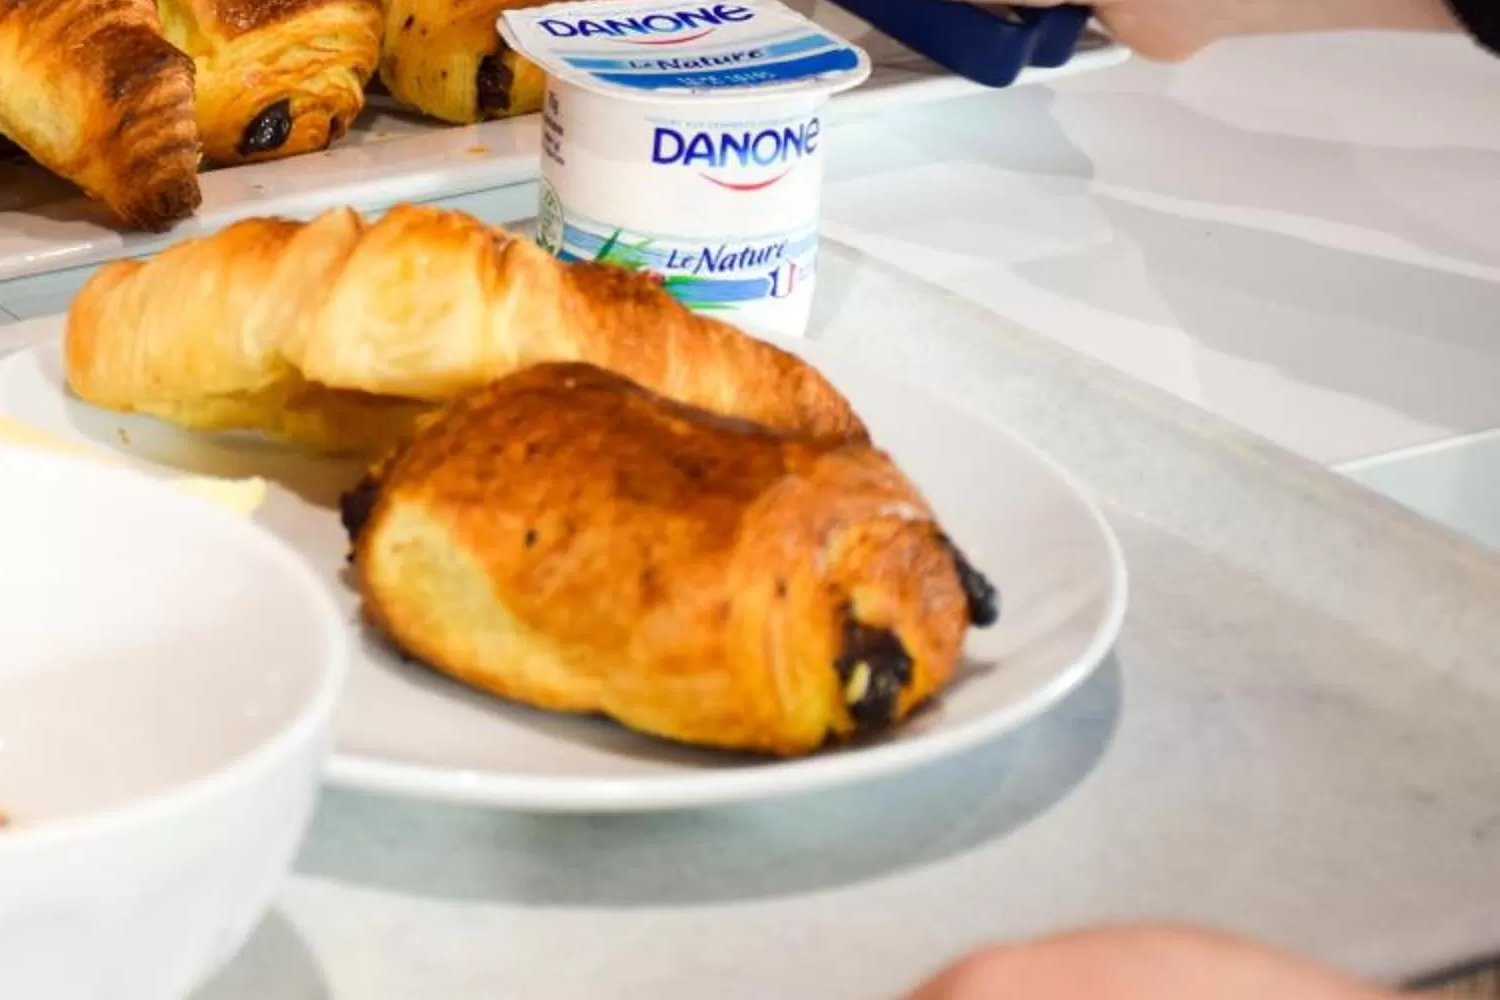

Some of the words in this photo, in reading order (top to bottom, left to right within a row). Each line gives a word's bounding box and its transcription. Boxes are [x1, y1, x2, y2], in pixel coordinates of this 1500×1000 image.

[537, 3, 754, 38] DANONE
[656, 49, 764, 71] Nature
[652, 117, 820, 168] DANONE
[666, 248, 694, 269] Le
